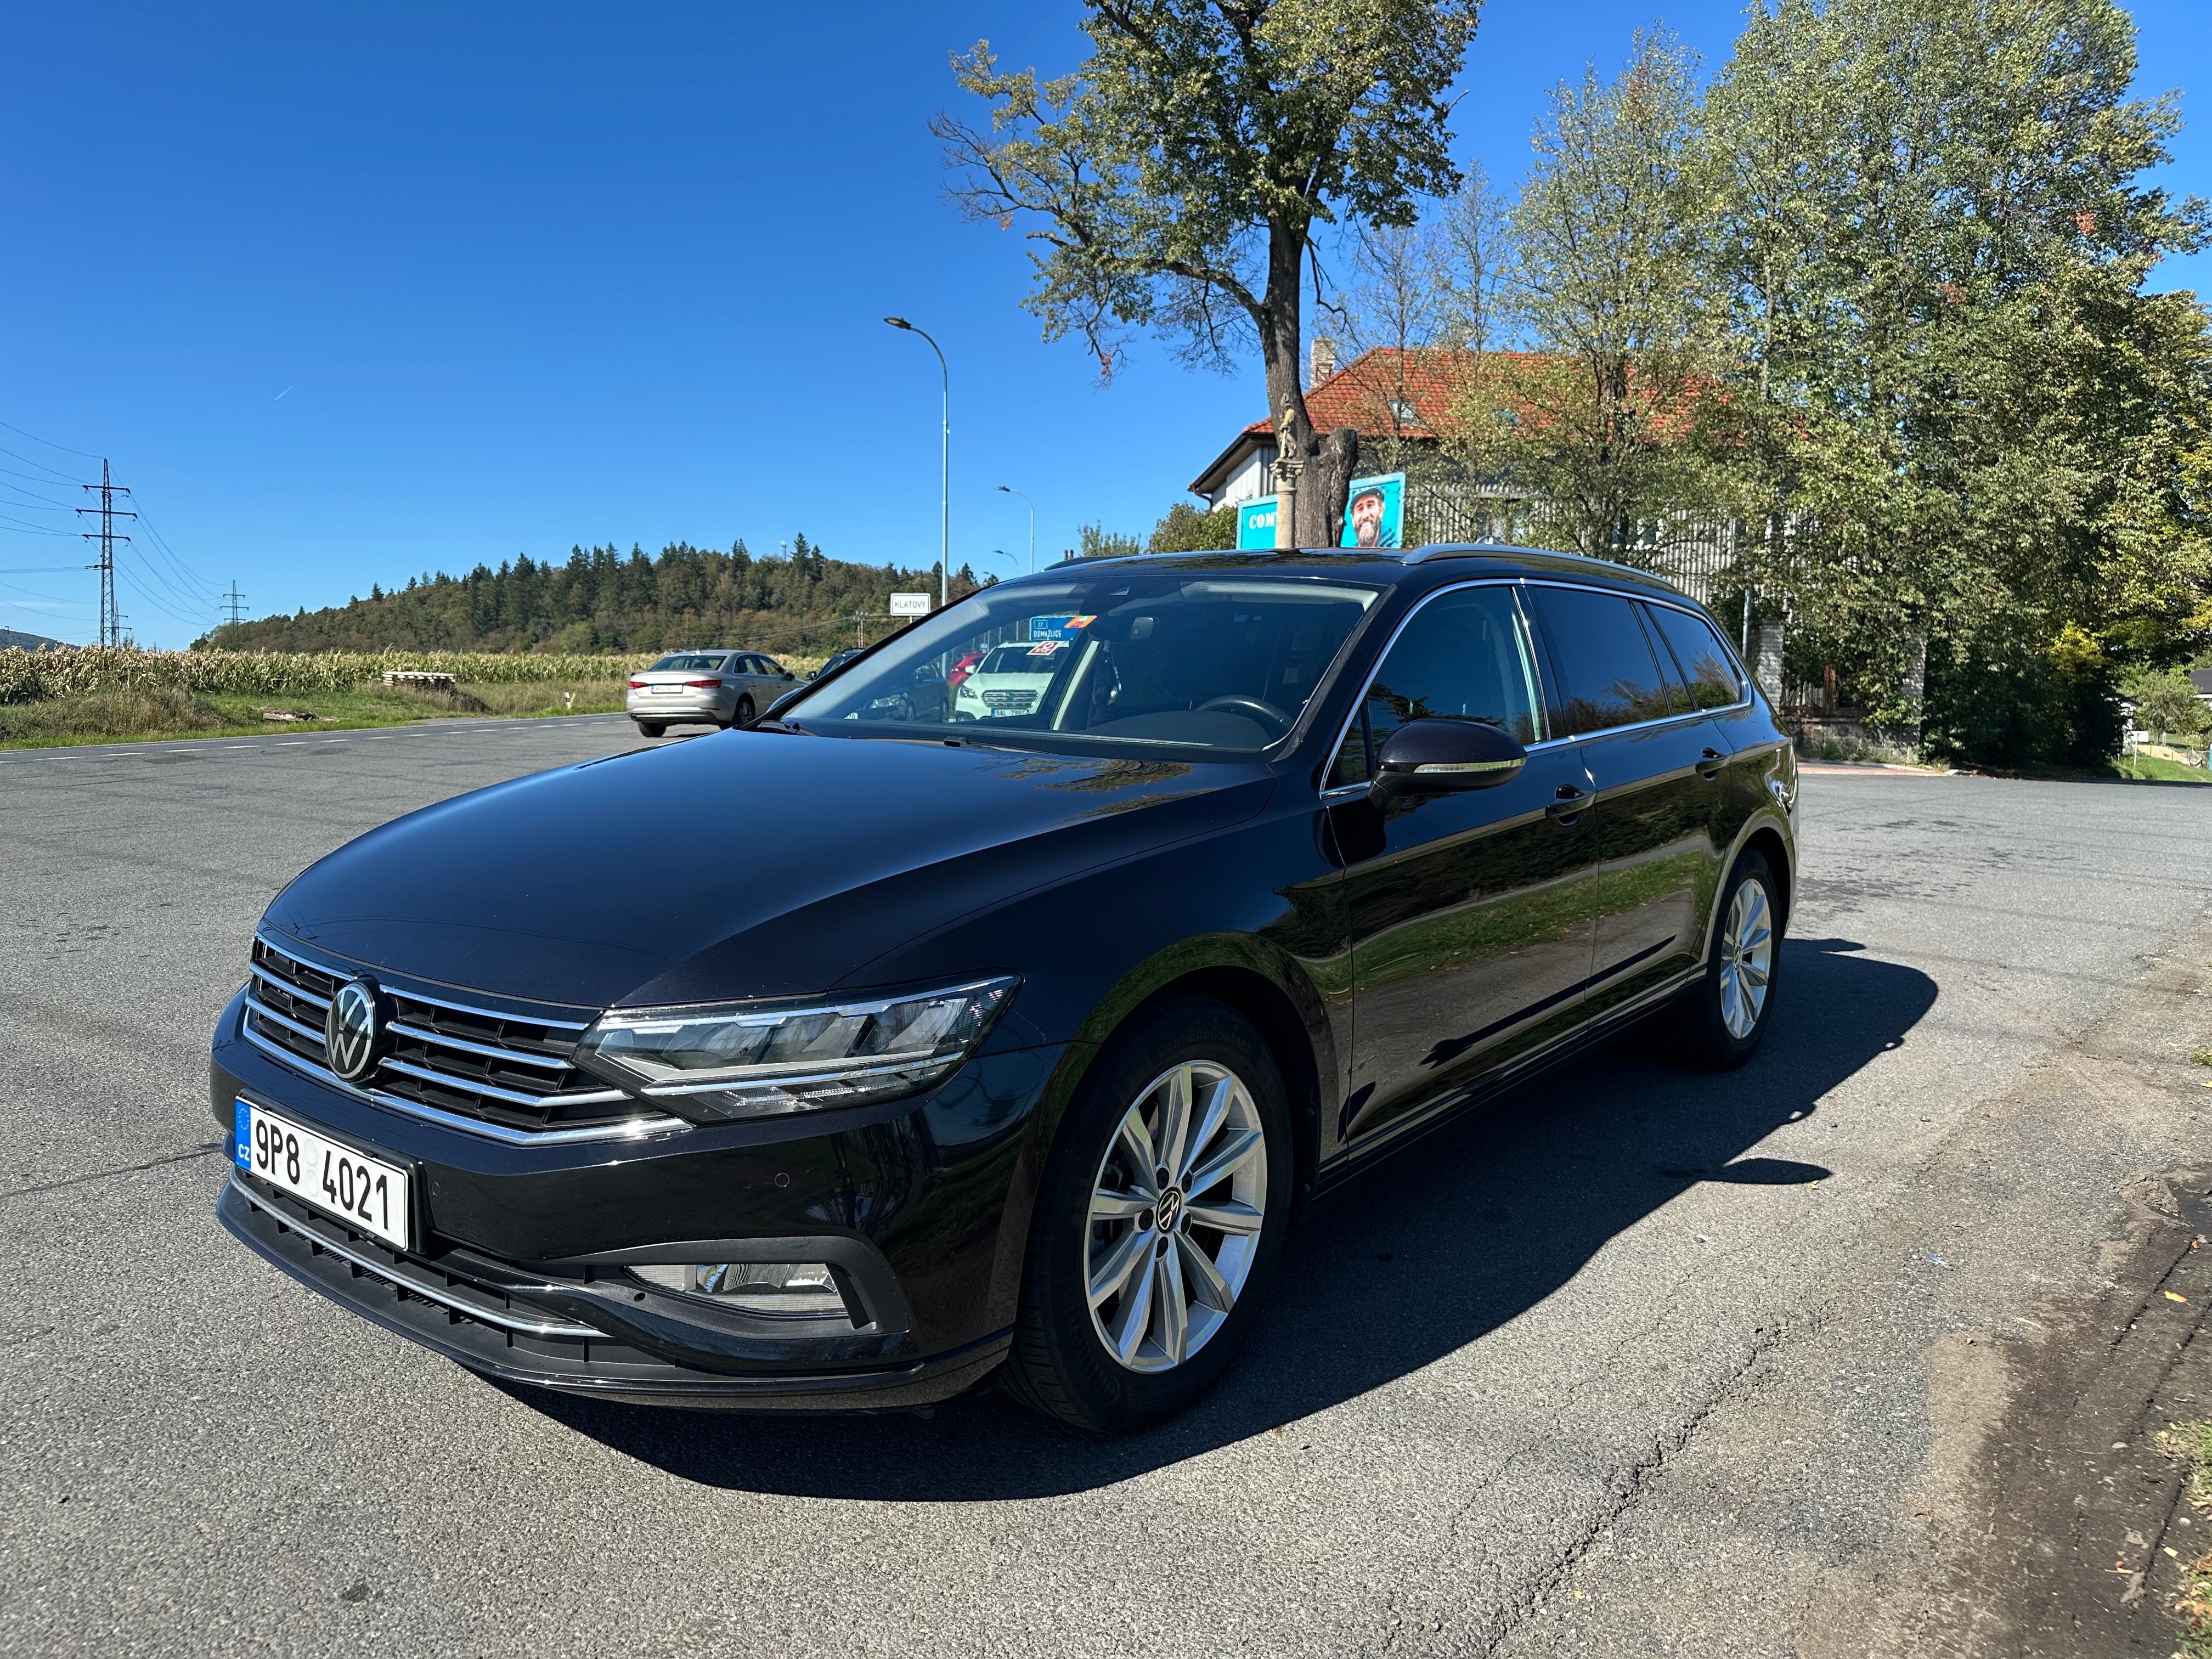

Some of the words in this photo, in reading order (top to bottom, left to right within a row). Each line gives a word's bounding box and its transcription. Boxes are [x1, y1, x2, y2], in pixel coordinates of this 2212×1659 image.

[1249, 511, 1278, 529] COM
[1033, 629, 1062, 638] DOMAŽLICE
[238, 1143, 250, 1161] CZ
[256, 1119, 300, 1185] 9P8
[323, 1150, 389, 1231] 4021
